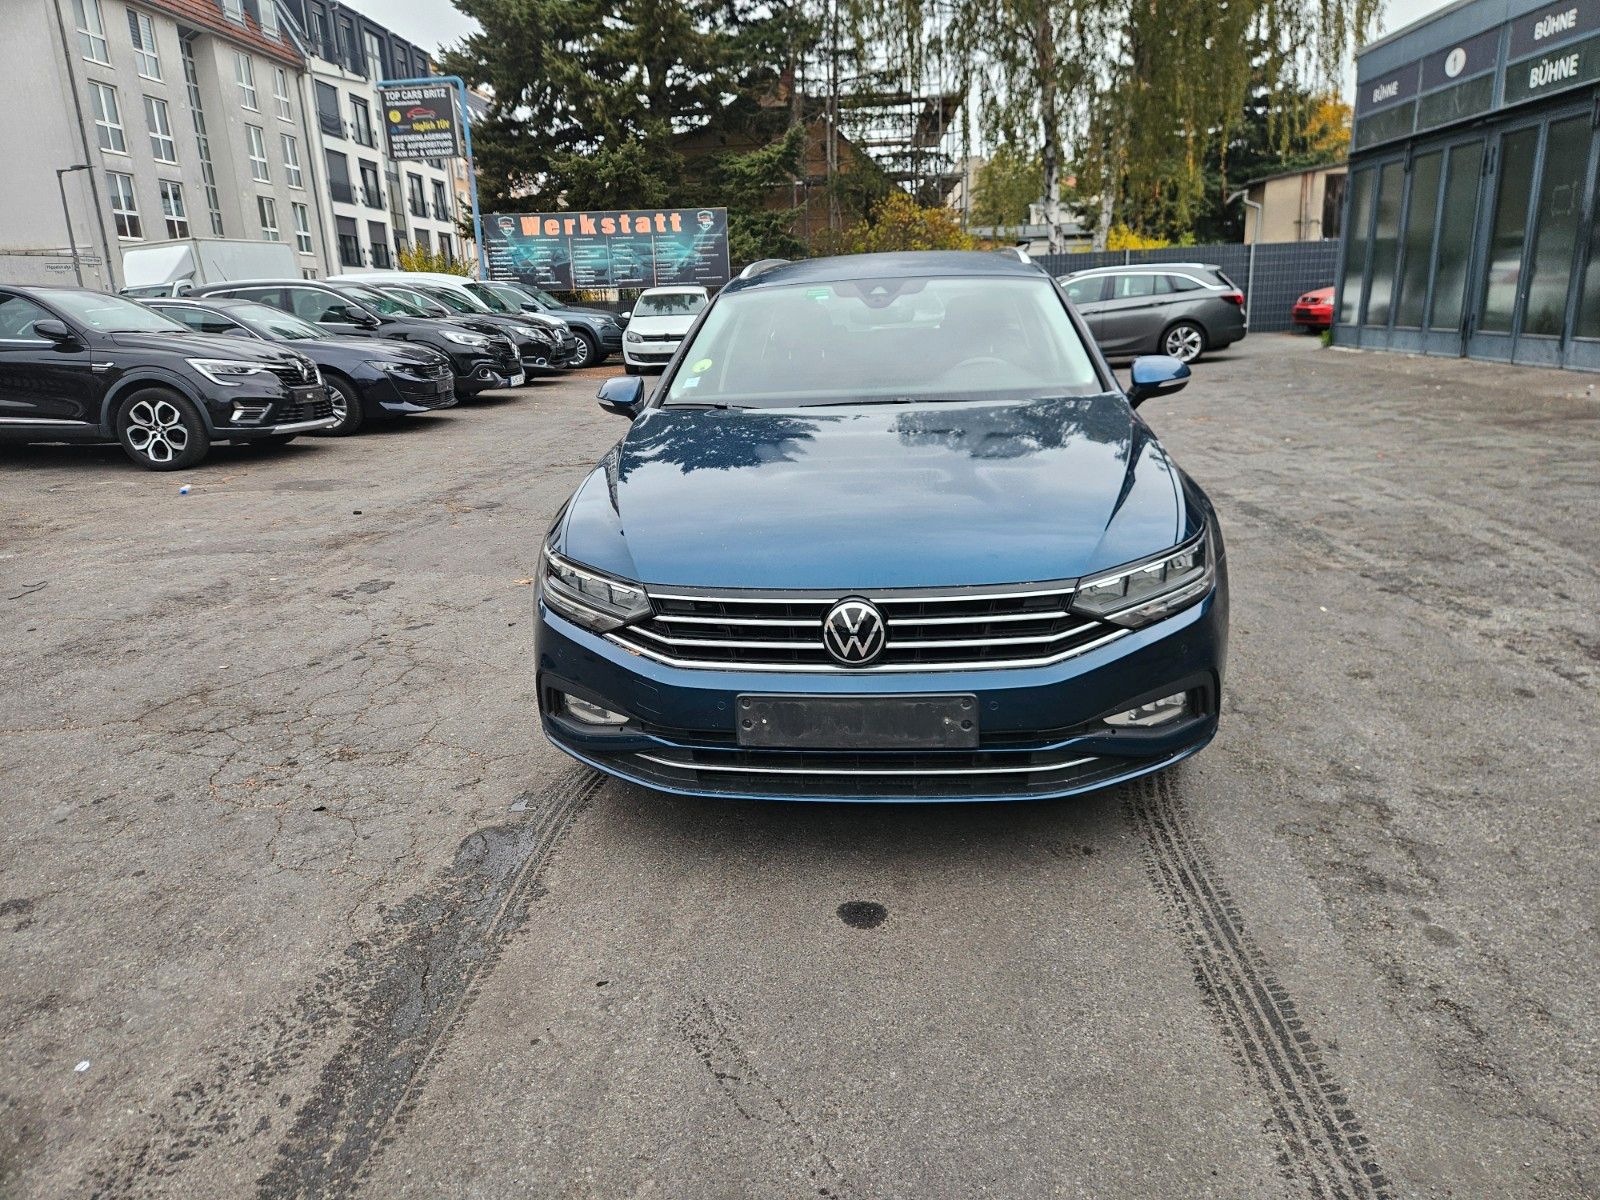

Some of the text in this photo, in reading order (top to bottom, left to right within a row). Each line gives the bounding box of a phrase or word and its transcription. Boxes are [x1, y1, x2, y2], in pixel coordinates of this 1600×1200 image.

[1533, 8, 1578, 40] BÜHNE
[1529, 53, 1580, 88] BÜHNE
[385, 88, 447, 100] TOP CARS BRITZ
[1373, 81, 1399, 103] BÜHNE
[520, 212, 682, 236] Werkstatt
